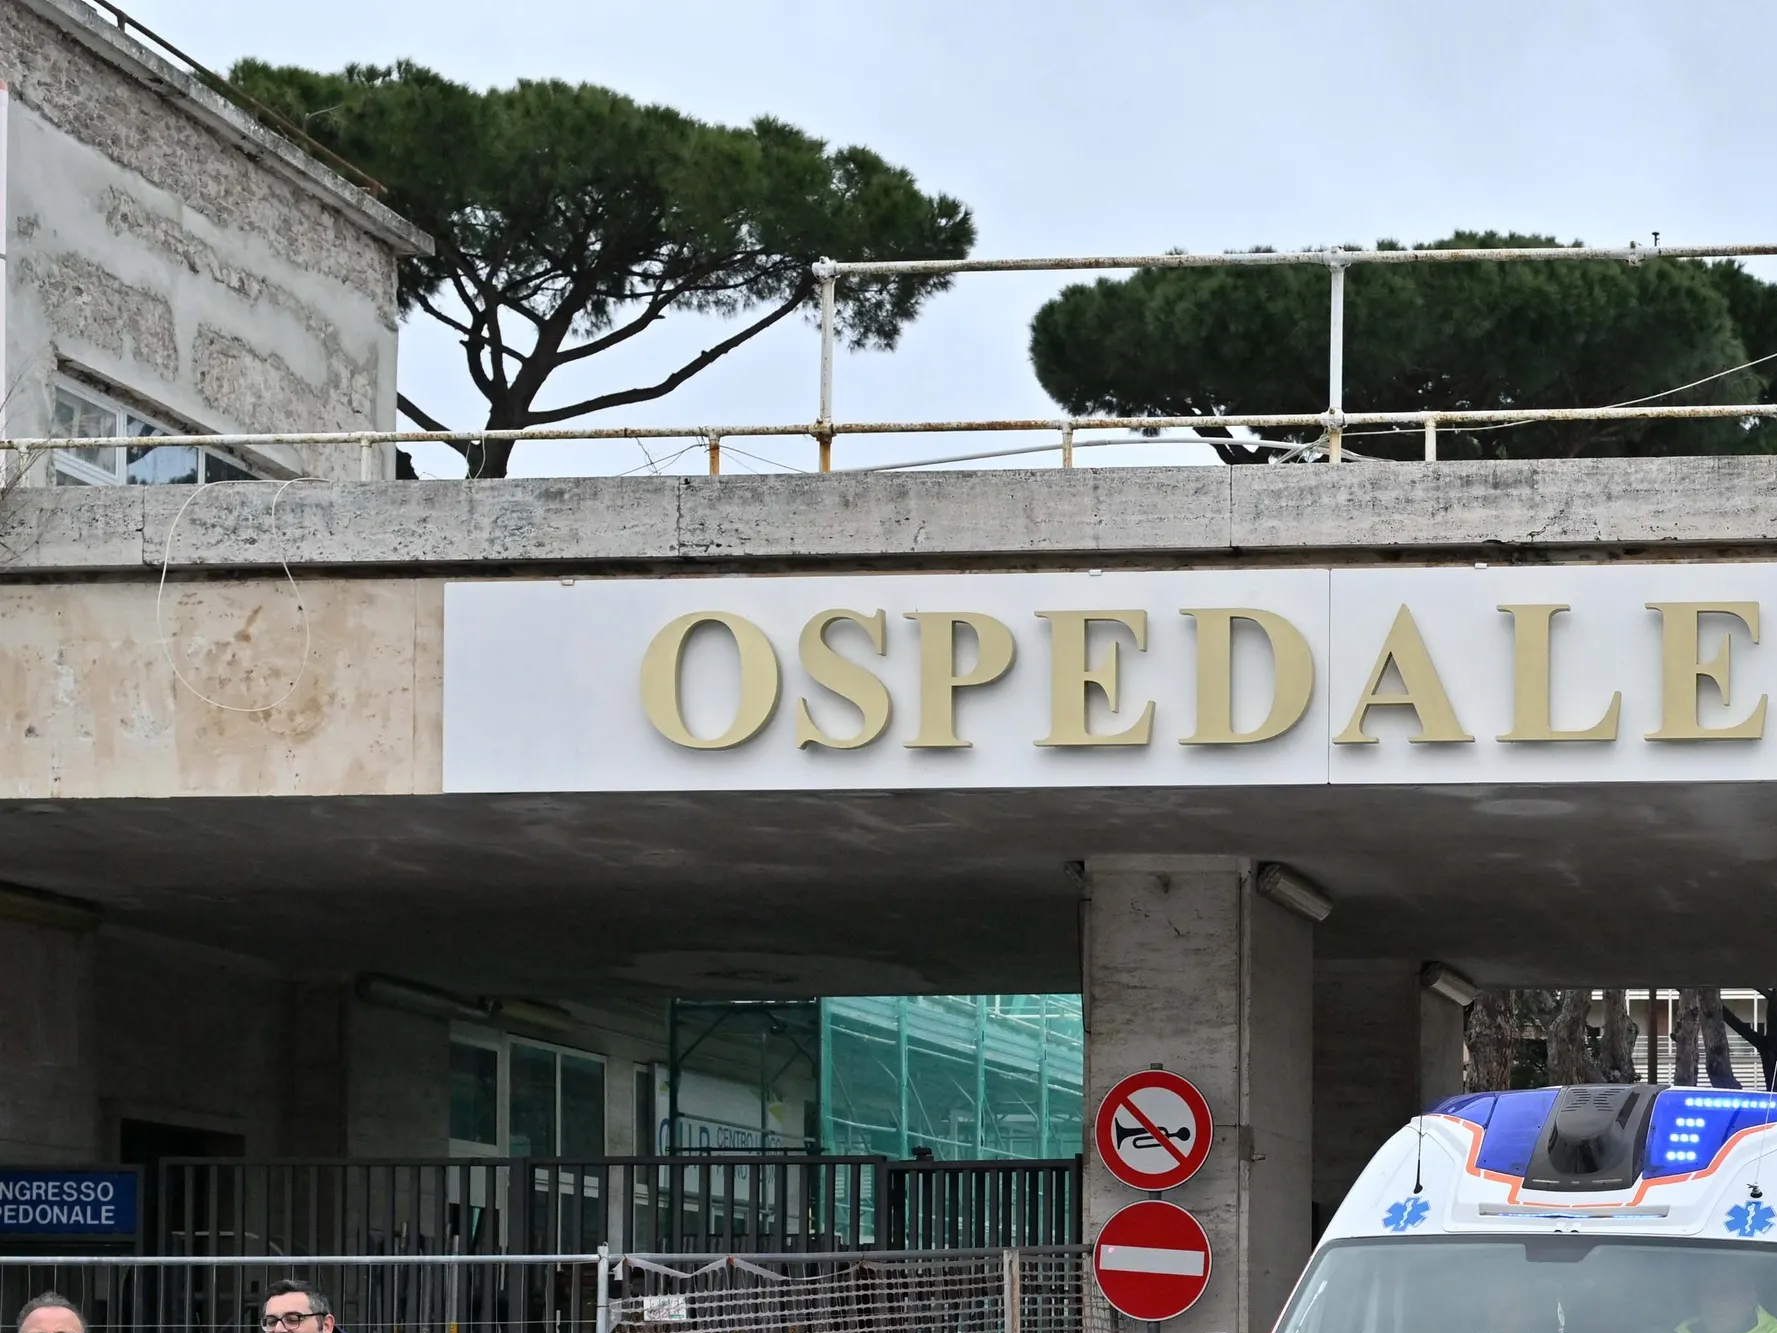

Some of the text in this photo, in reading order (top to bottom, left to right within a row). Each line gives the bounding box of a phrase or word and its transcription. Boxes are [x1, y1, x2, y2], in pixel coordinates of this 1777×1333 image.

[640, 603, 1768, 750] OSPEDALE
[0, 1181, 114, 1201] NGRESSO
[0, 1204, 115, 1224] EDONALE
